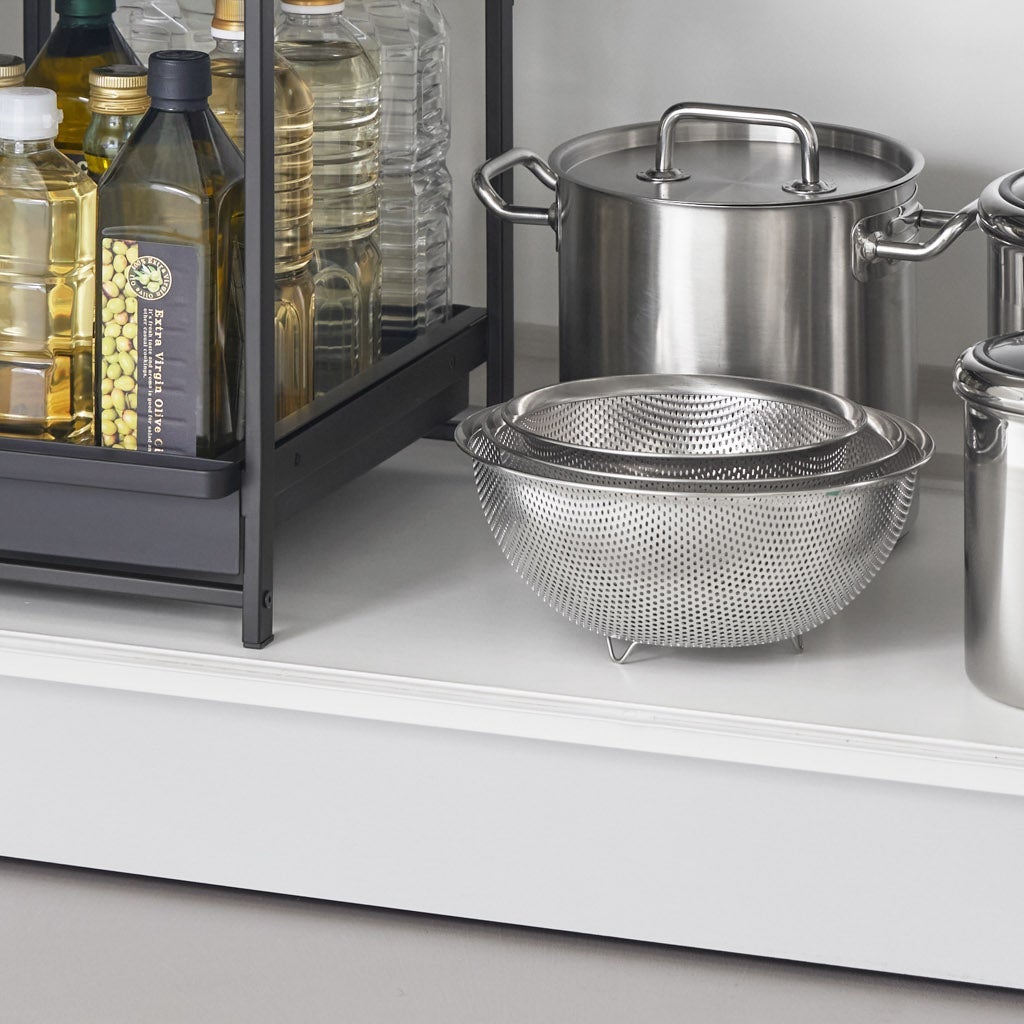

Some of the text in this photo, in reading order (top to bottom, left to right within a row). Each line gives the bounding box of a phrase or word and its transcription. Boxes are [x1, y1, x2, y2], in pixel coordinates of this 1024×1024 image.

[148, 257, 166, 273] Extra
[135, 287, 154, 299] Olive
[156, 273, 170, 296] Virgin
[154, 309, 164, 347] Extra
[152, 351, 164, 394] Virgin
[154, 398, 164, 433] Olive
